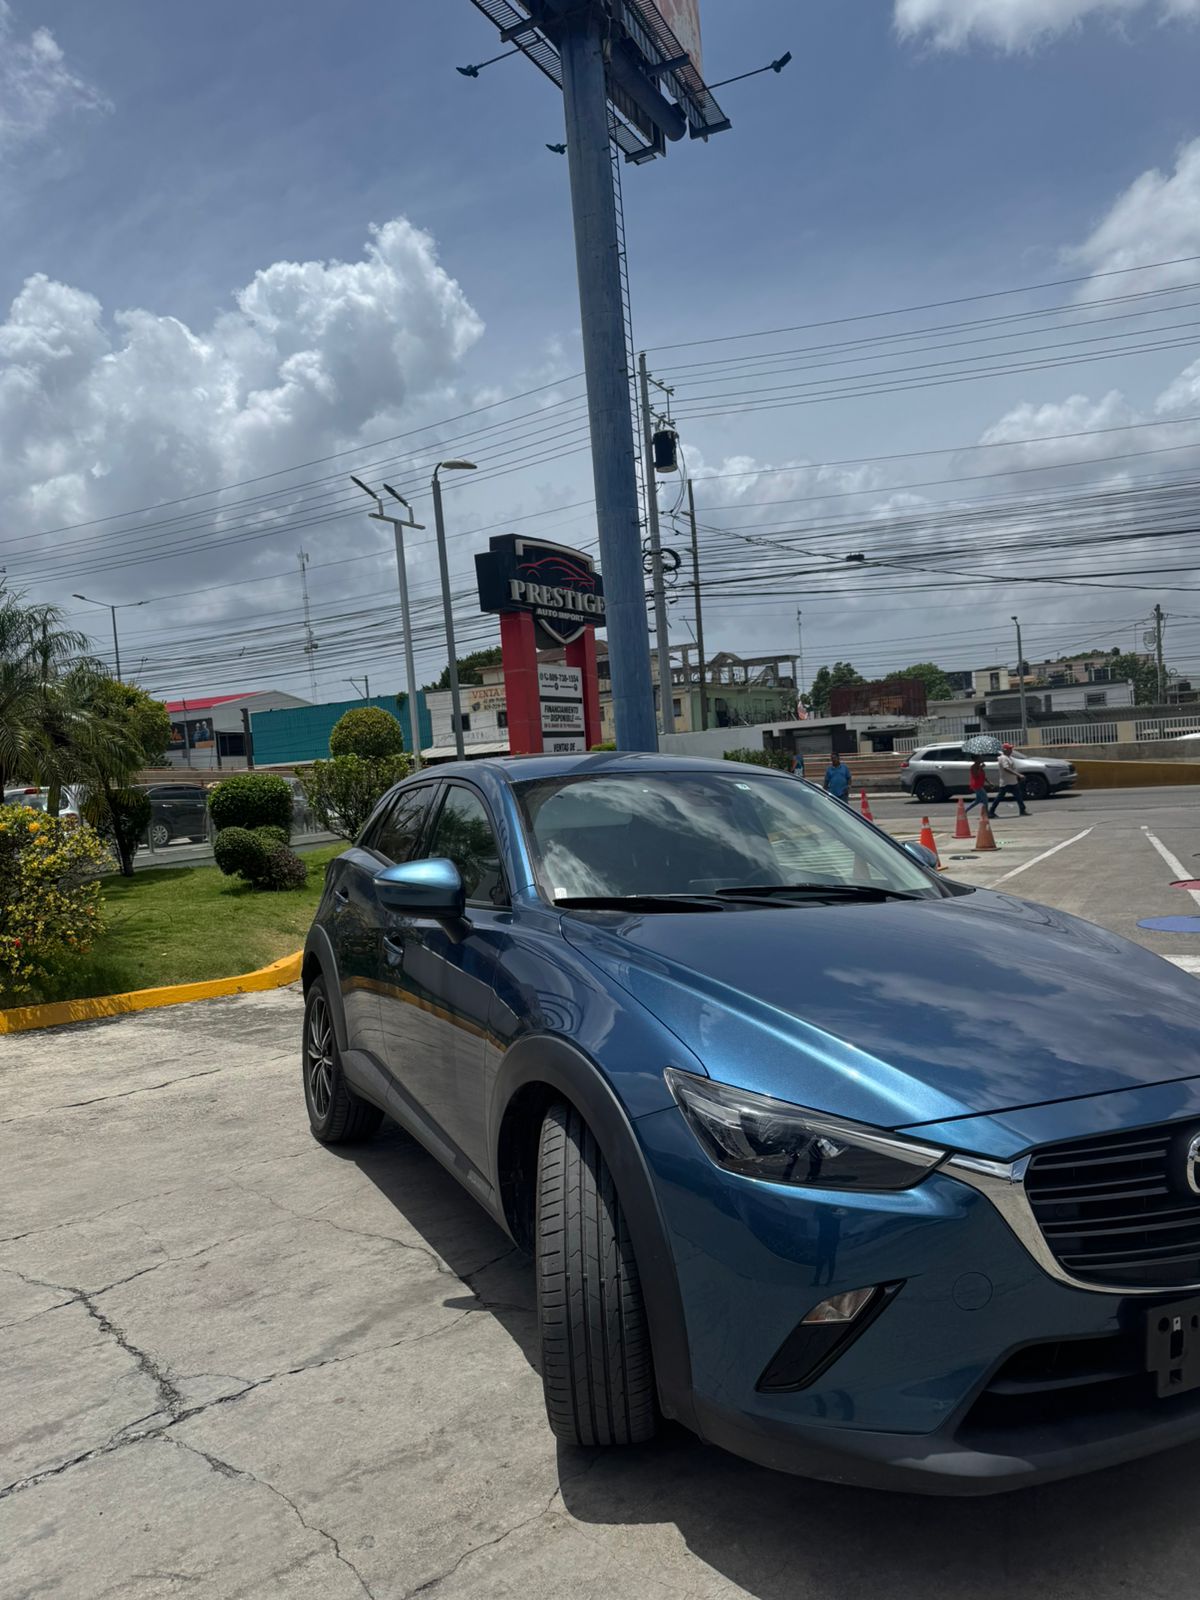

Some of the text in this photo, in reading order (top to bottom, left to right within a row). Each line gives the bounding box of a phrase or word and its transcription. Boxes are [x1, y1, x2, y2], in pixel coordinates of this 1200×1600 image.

[509, 578, 606, 614] PRESTIGE
[536, 607, 585, 622] AUTO IMPORT
[544, 704, 579, 714] FINANCIAMIENTO
[550, 713, 575, 722] DISPONIBLE
[554, 742, 576, 752] VENTAS DE
